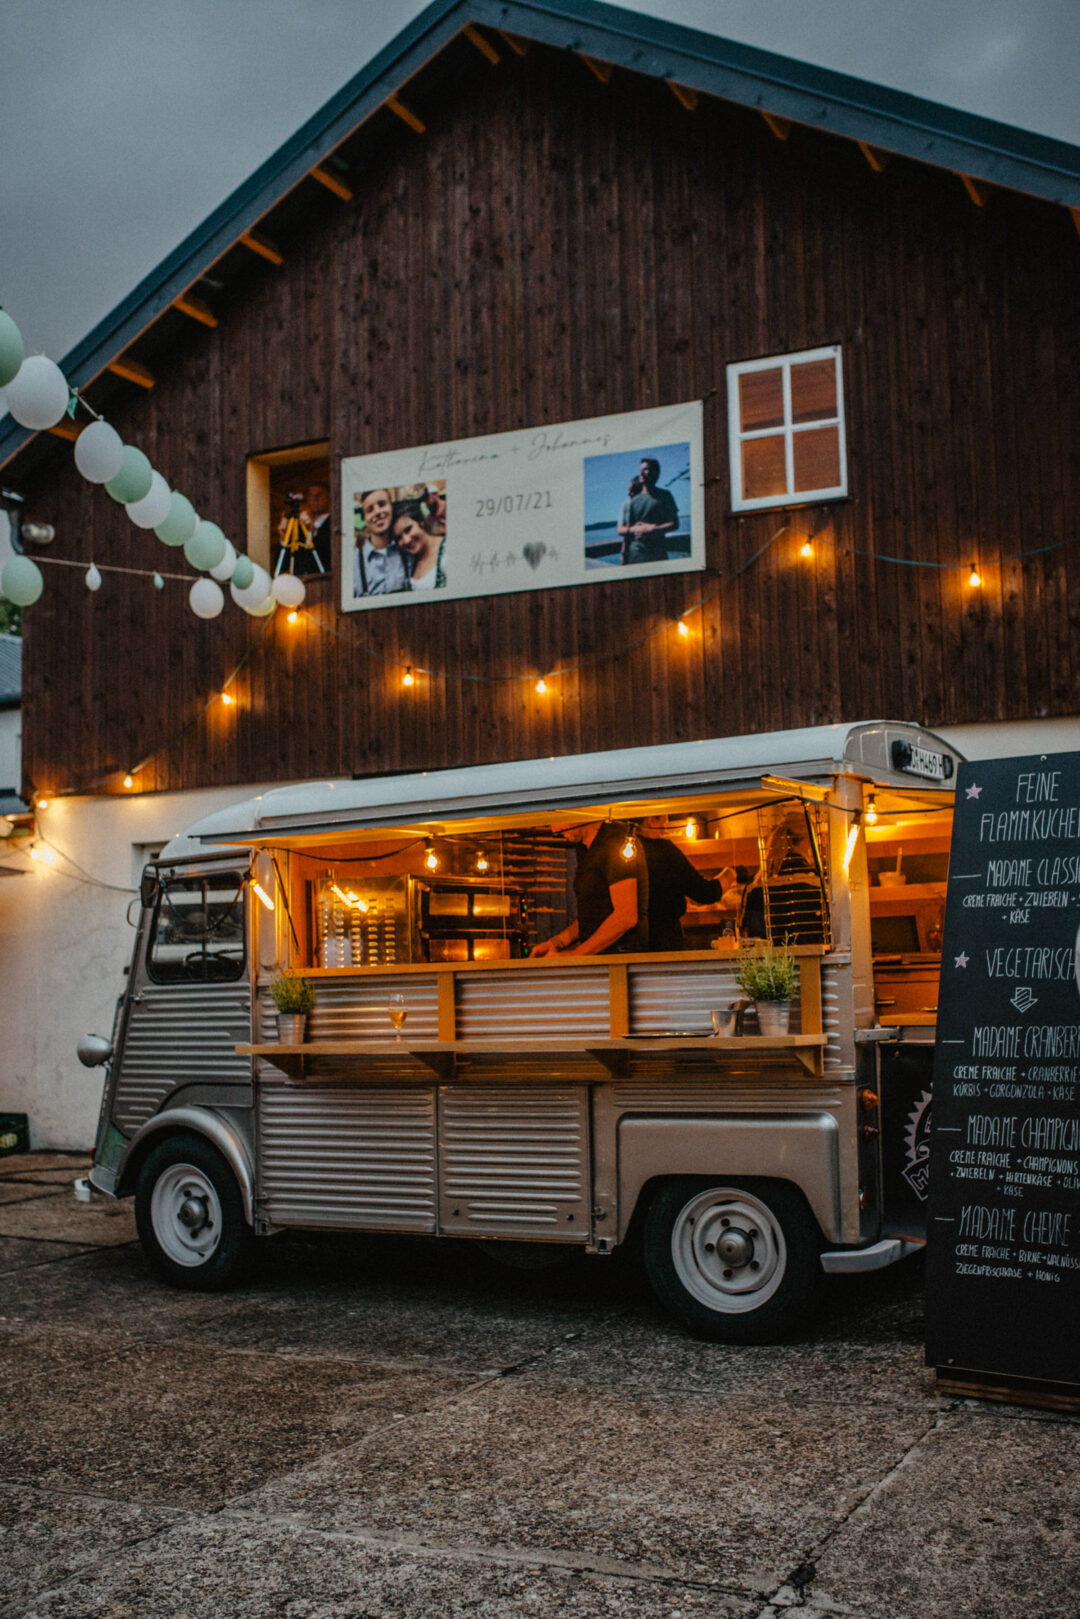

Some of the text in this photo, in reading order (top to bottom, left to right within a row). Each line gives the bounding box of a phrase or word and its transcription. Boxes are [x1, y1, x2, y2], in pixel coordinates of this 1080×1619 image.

[475, 491, 553, 518] 29/07/21
[1016, 771, 1062, 803] FEINE
[980, 807, 1080, 842] FLAMMKUCHE
[986, 856, 1080, 887] MADAME CLASSI
[962, 893, 984, 907] CREME
[986, 892, 1018, 907] FRAICHE
[1024, 891, 1069, 907] ZWIEBELN
[985, 947, 1077, 980] VEGETARISCH
[972, 1026, 1023, 1058] MADAME
[953, 1065, 980, 1080] CREME
[981, 1065, 1017, 1081] FRAICHE
[1027, 1065, 1080, 1083] CRANBERRIE
[989, 1083, 1044, 1100] GORGONZOLA
[966, 1114, 1018, 1148] MADAME
[1020, 1116, 1080, 1151] CHAMPIGN
[949, 1150, 976, 1164] CREME
[977, 1151, 1012, 1169] FRAICHE
[955, 1166, 996, 1181] ZWIEBELN
[958, 1204, 1072, 1247] MADAME CHEVRE
[955, 1243, 979, 1257] CREME
[981, 1244, 1012, 1261] FRAICHE
[1046, 1253, 1080, 1270] WALNÜSS
